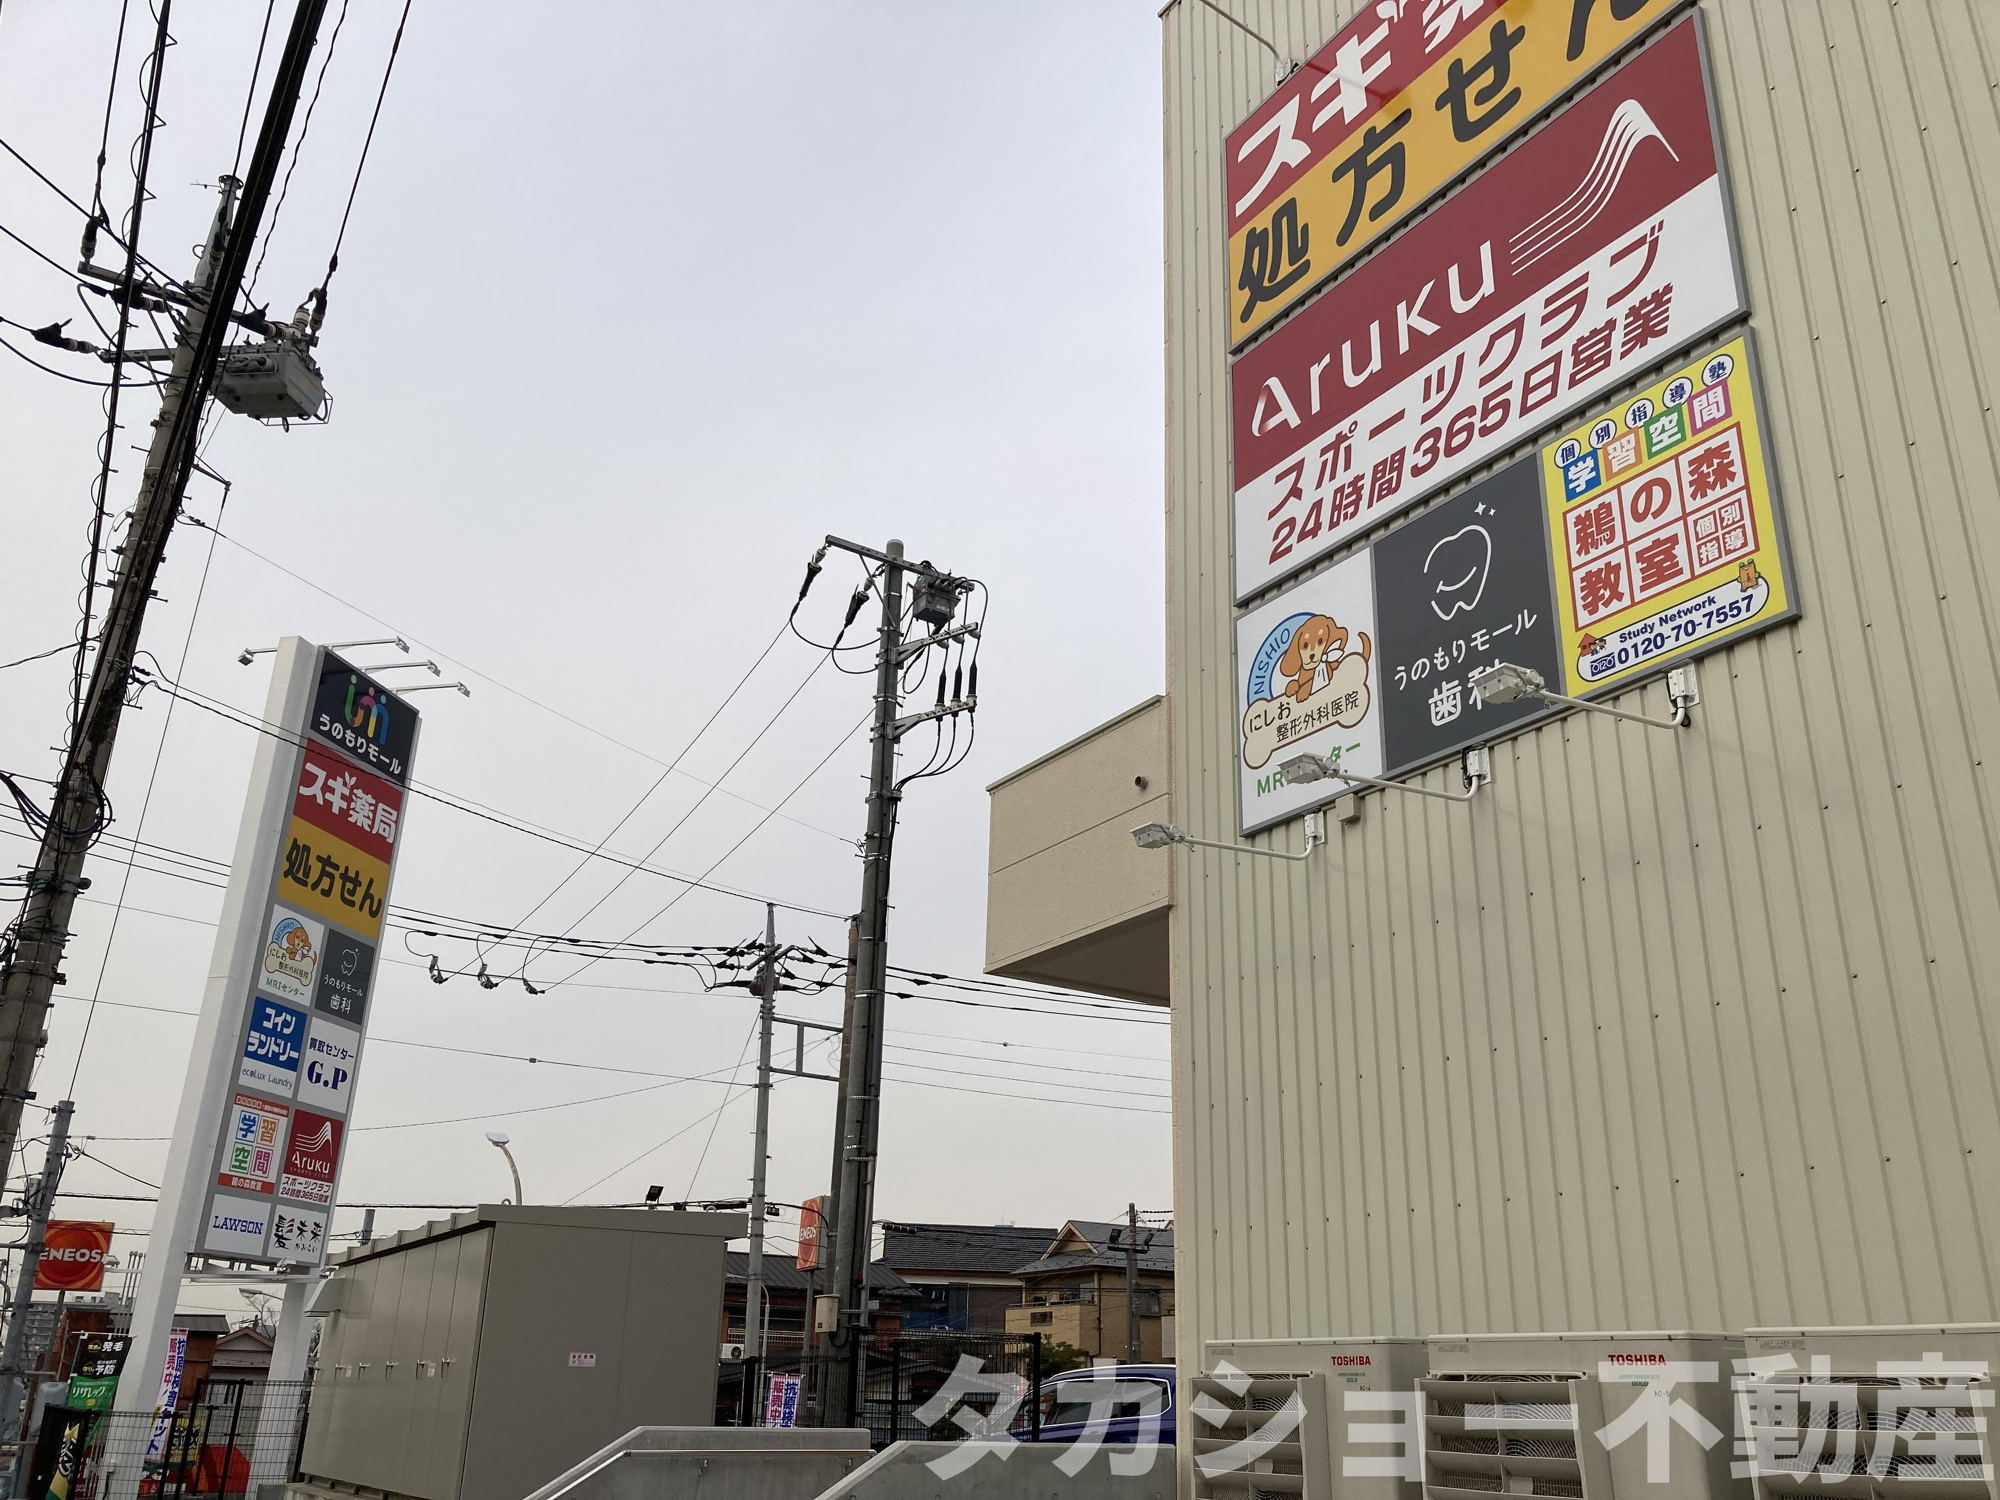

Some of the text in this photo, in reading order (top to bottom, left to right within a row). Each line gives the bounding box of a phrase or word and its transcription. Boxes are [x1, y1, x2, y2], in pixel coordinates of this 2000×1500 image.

[1267, 219, 1665, 521] スポーツクラブ
[1268, 282, 1674, 565] 24時間365日営業
[1559, 359, 1727, 464] 個別指導塾
[1567, 384, 1727, 494] 学習空間
[1573, 440, 1738, 557] 鵜の森
[1695, 501, 1741, 537] 個別
[1699, 528, 1746, 567] 指導
[1579, 532, 1685, 617] 教室
[1616, 593, 1755, 665] 0120-70-7557
[1618, 595, 1717, 644] Study Network
[1253, 627, 1291, 695] NISHIO
[1394, 608, 1538, 691] うのもりモール
[1249, 701, 1292, 733] にしお
[1276, 690, 1360, 744] 整形外科医院
[319, 712, 402, 775] うのもりモール
[299, 762, 398, 843] スギ薬局
[283, 837, 382, 918] 処方せん
[274, 921, 295, 942] NISHIO
[269, 948, 287, 962] にしお
[266, 977, 305, 997] MRIセンター
[324, 974, 363, 997] うのもりモール
[330, 994, 352, 1014] 歯科
[262, 1006, 296, 1034] コイン
[247, 1030, 300, 1062] ランドリー
[308, 1036, 354, 1060] 買取センター
[267, 1073, 294, 1091] Laundry
[307, 1060, 348, 1091] G.P
[239, 1113, 277, 1144] 学習
[231, 1146, 271, 1175] 空間
[280, 1186, 330, 1204] 24時間365日営業
[282, 1176, 331, 1194] スポーツクラブ
[212, 1215, 264, 1236] LAWSON
[800, 1226, 817, 1241] ENEOS
[38, 1247, 102, 1263] ENEOS
[1331, 1355, 1372, 1366] TOSHIBA
[1608, 1354, 1667, 1366] TOSHIBA
